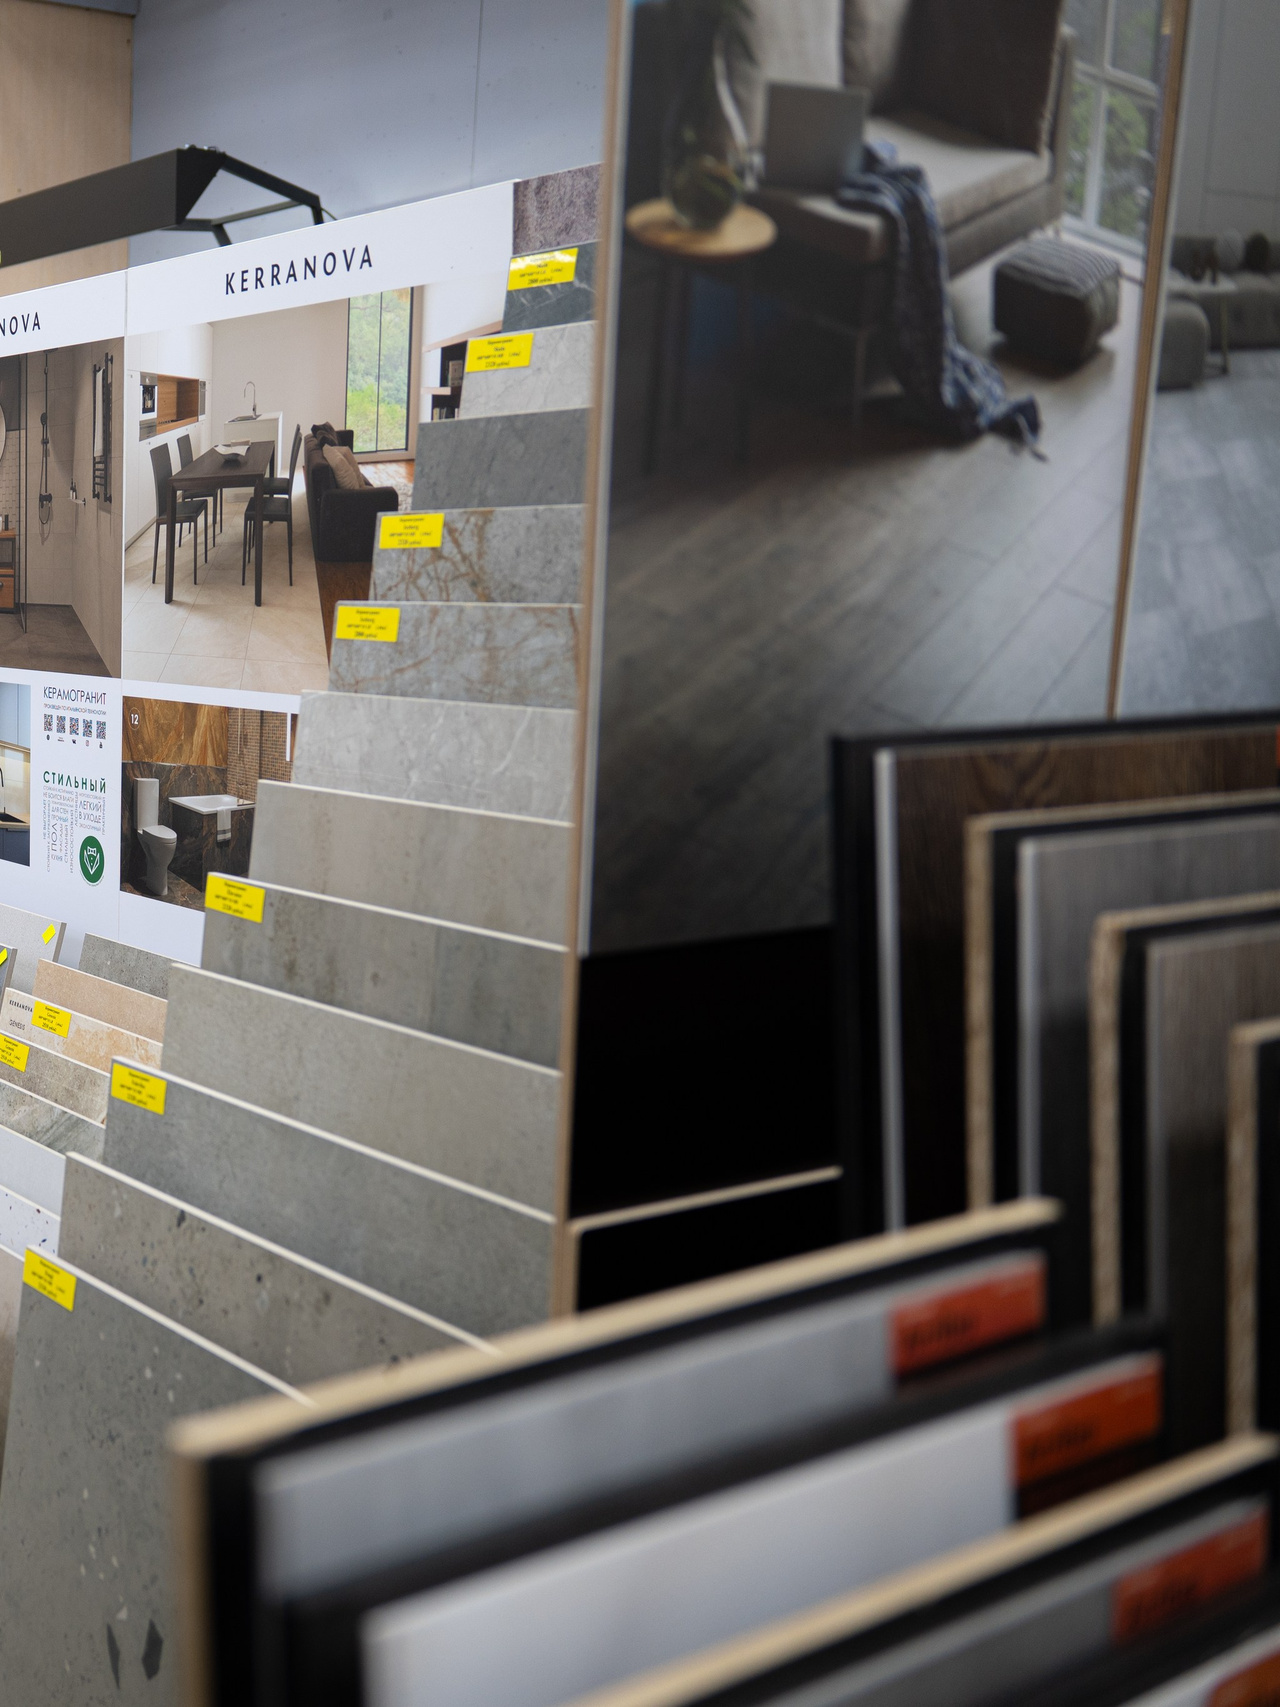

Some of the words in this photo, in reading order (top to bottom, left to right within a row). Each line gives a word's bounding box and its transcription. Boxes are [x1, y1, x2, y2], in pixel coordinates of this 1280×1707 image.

[225, 244, 374, 296] KERRANOVA
[44, 686, 106, 705] КЕРАМОГРАНИТ
[130, 714, 139, 724] 12
[43, 770, 106, 794] СТИЛЬНЫЙ
[9, 1000, 33, 1012] KERRANOVA
[9, 1020, 25, 1030] GENESIS
